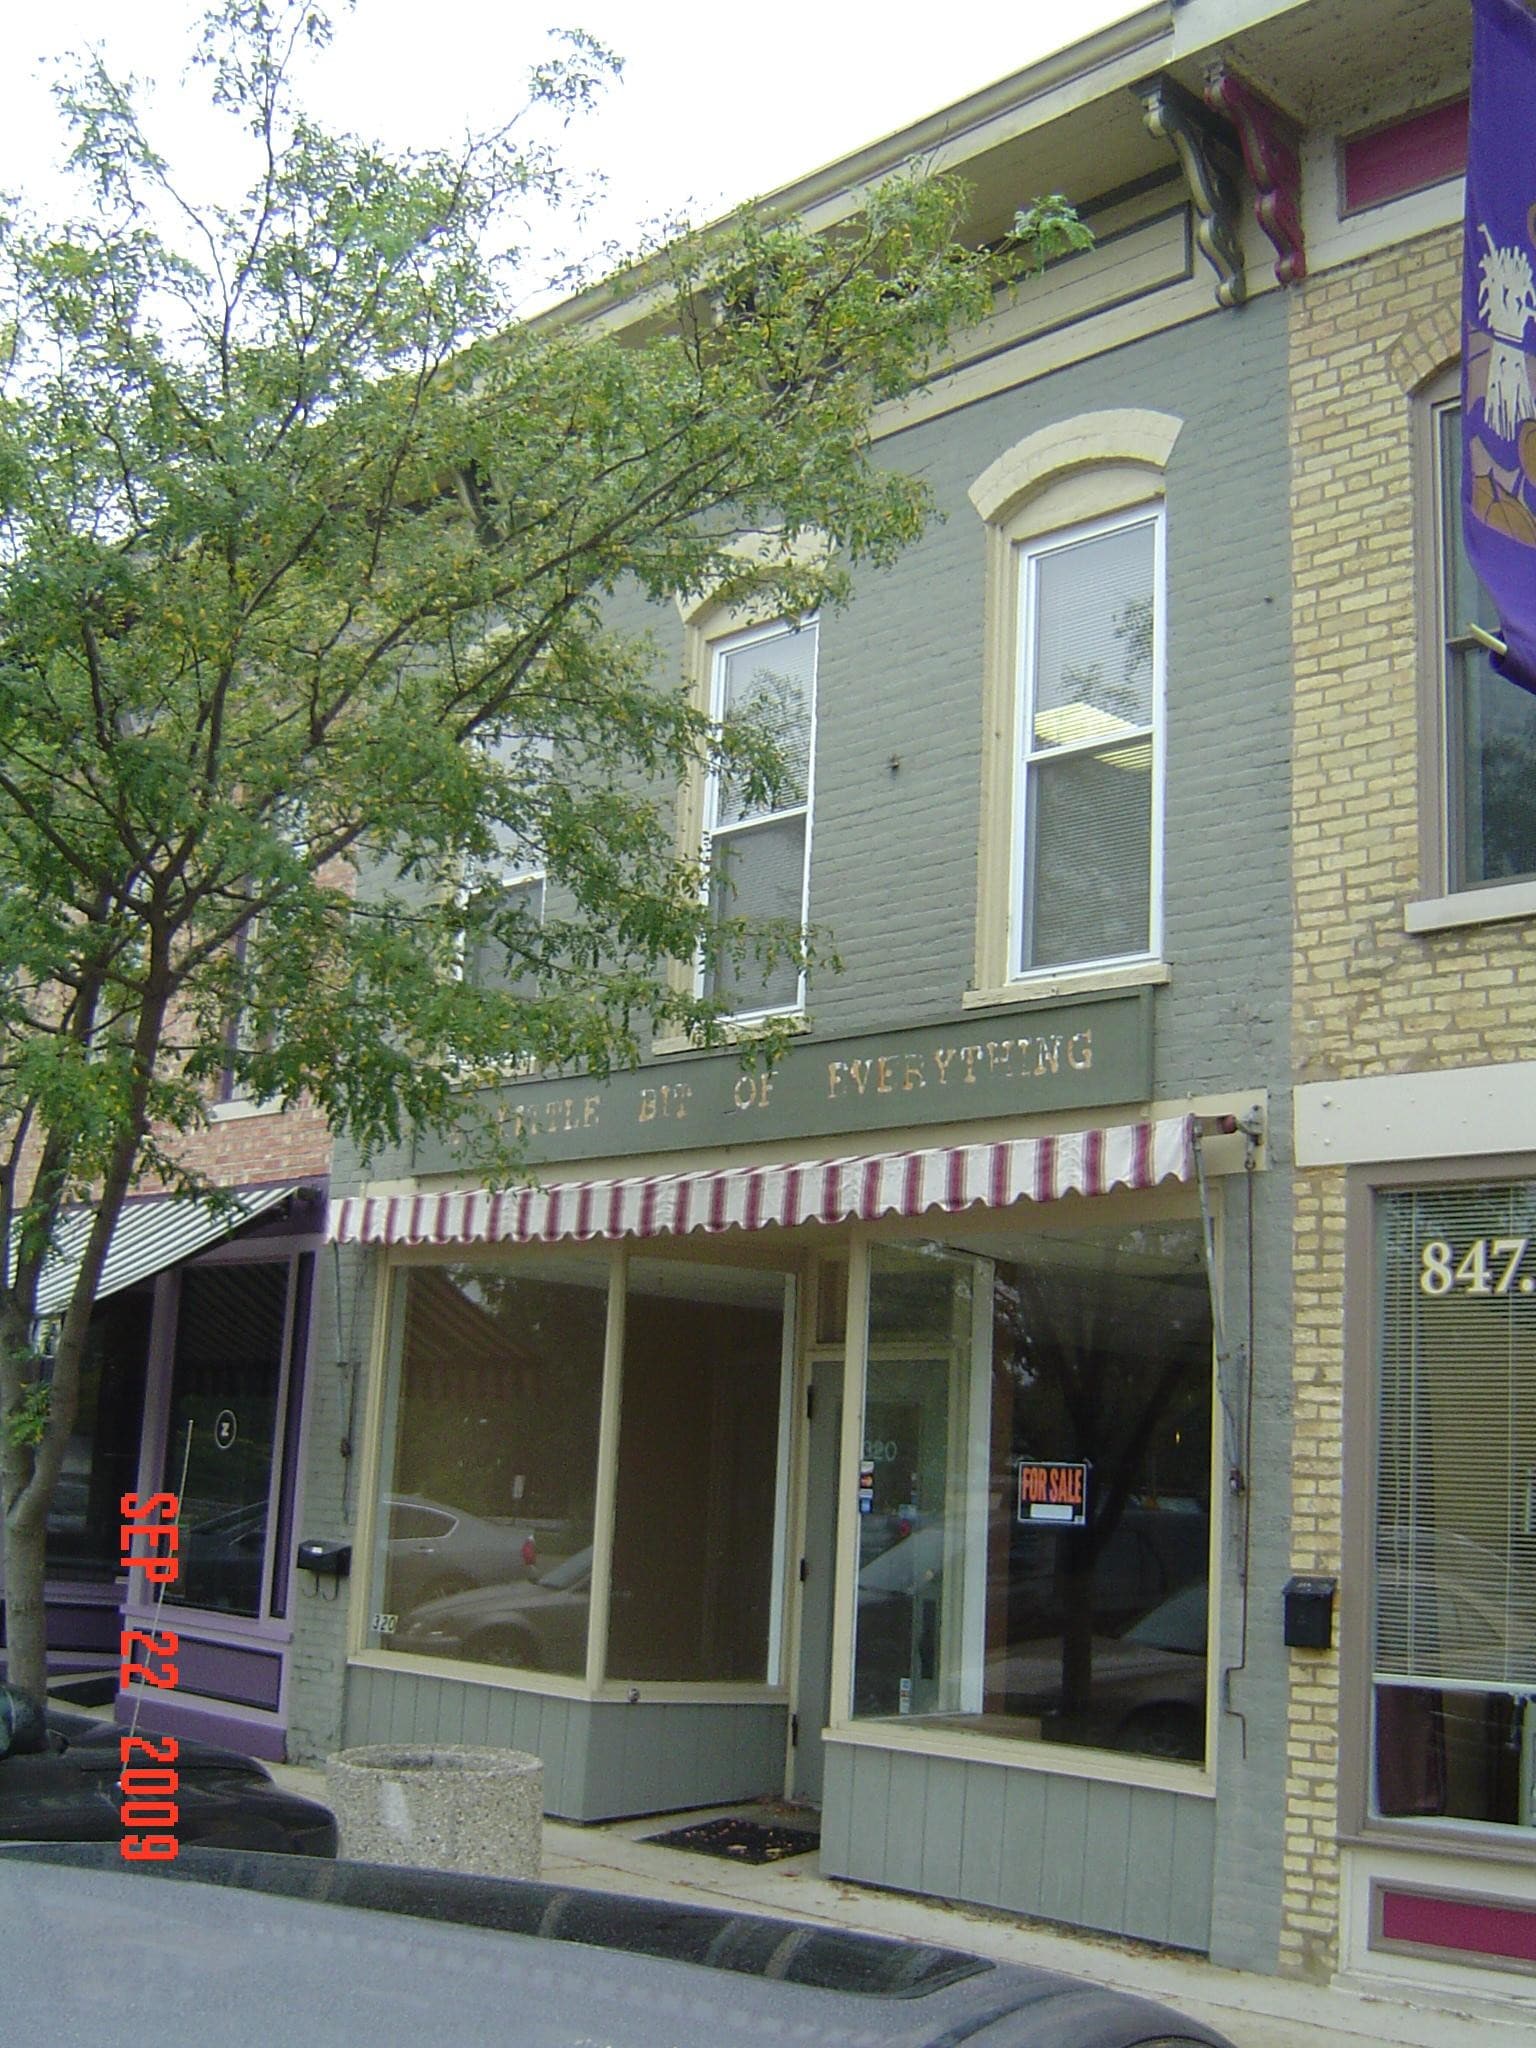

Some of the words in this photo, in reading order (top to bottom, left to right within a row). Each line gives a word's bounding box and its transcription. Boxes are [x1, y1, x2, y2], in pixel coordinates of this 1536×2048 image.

[638, 1081, 693, 1122] BIT
[734, 1070, 779, 1110] OF
[828, 1029, 1093, 1099] EVERYTHING
[1420, 1238, 1536, 1295] 847.
[1022, 1466, 1048, 1502] FOR
[1049, 1468, 1083, 1504] SALE
